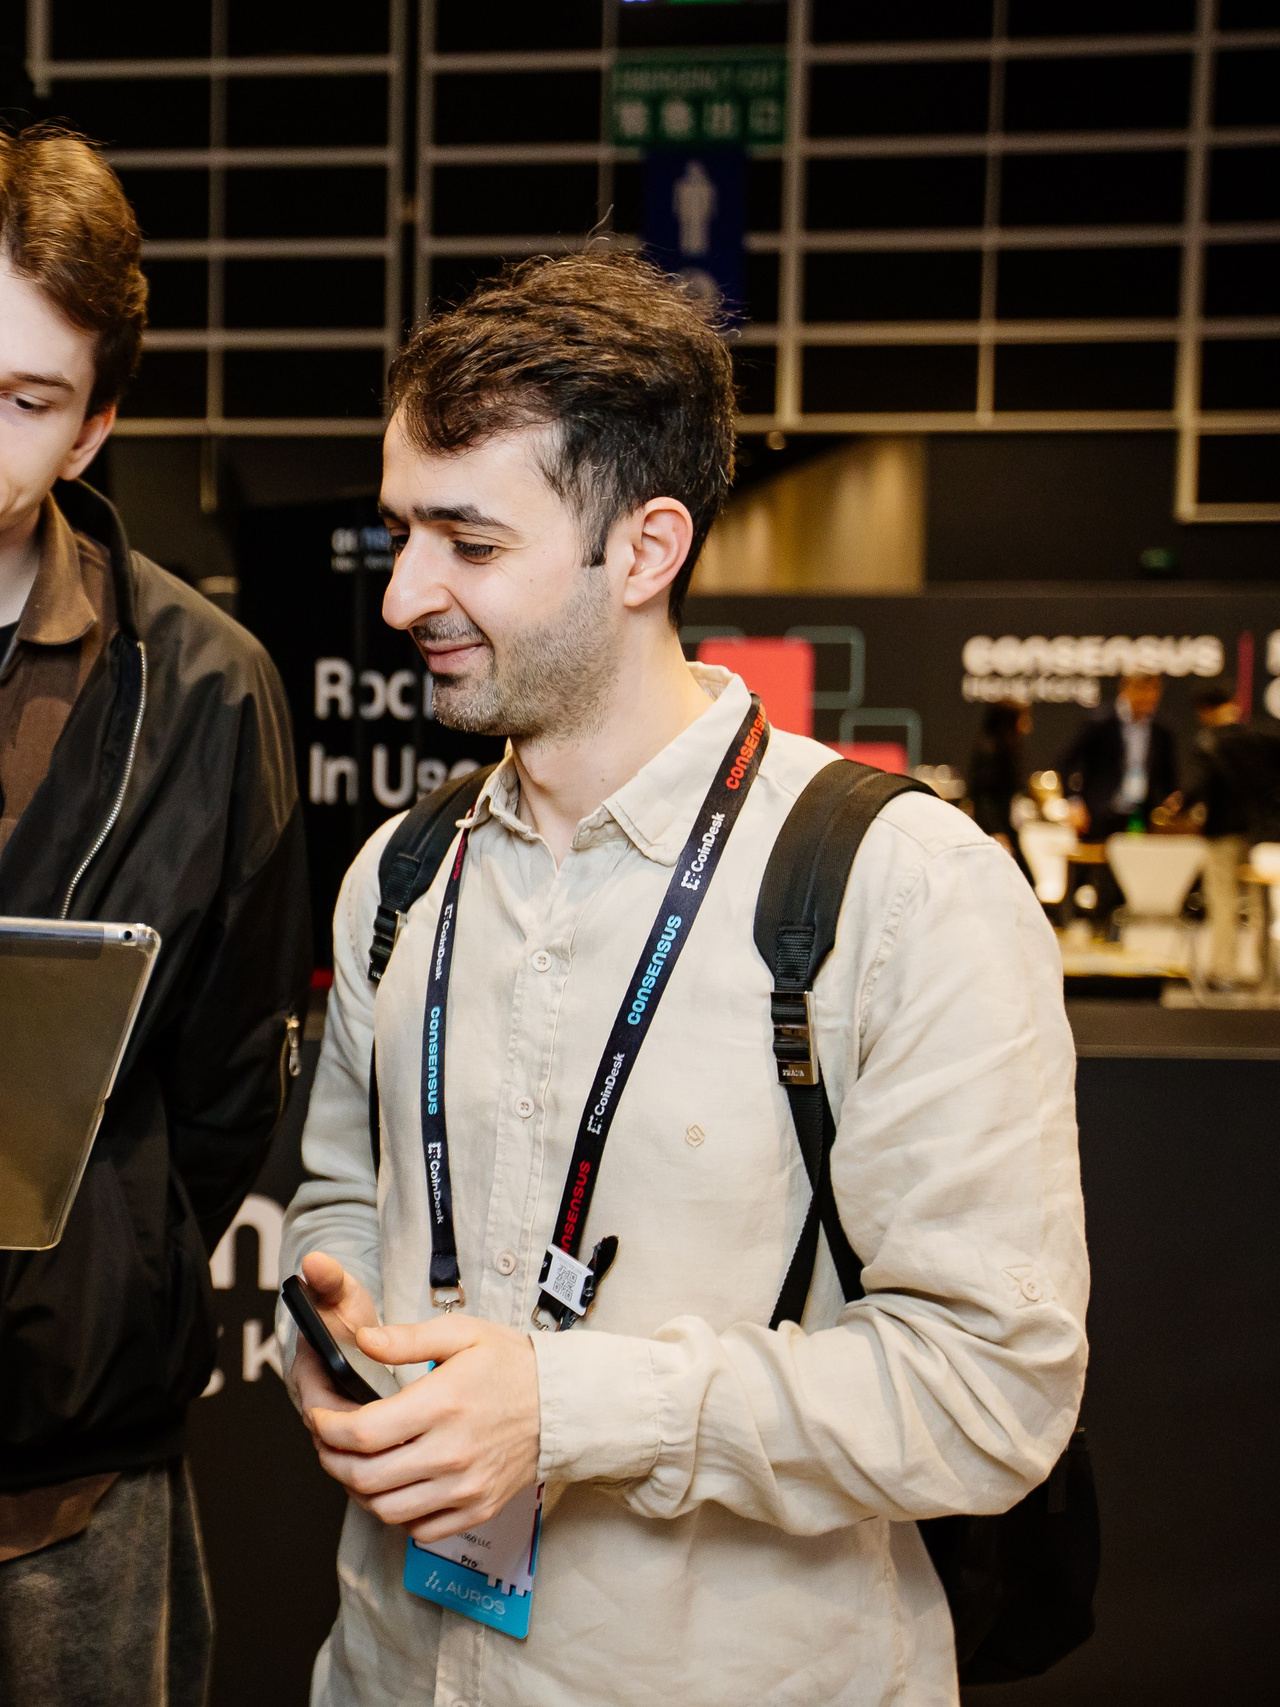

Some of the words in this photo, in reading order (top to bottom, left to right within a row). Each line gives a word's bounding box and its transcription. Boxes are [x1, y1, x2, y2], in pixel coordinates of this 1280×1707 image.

[309, 742, 359, 807] In
[691, 811, 726, 873] CoinDesk
[435, 919, 450, 981] CoinDesk
[594, 1051, 626, 1116] CoinDesk
[430, 1159, 445, 1225] CoinDesk
[445, 1581, 506, 1615] AUROS
